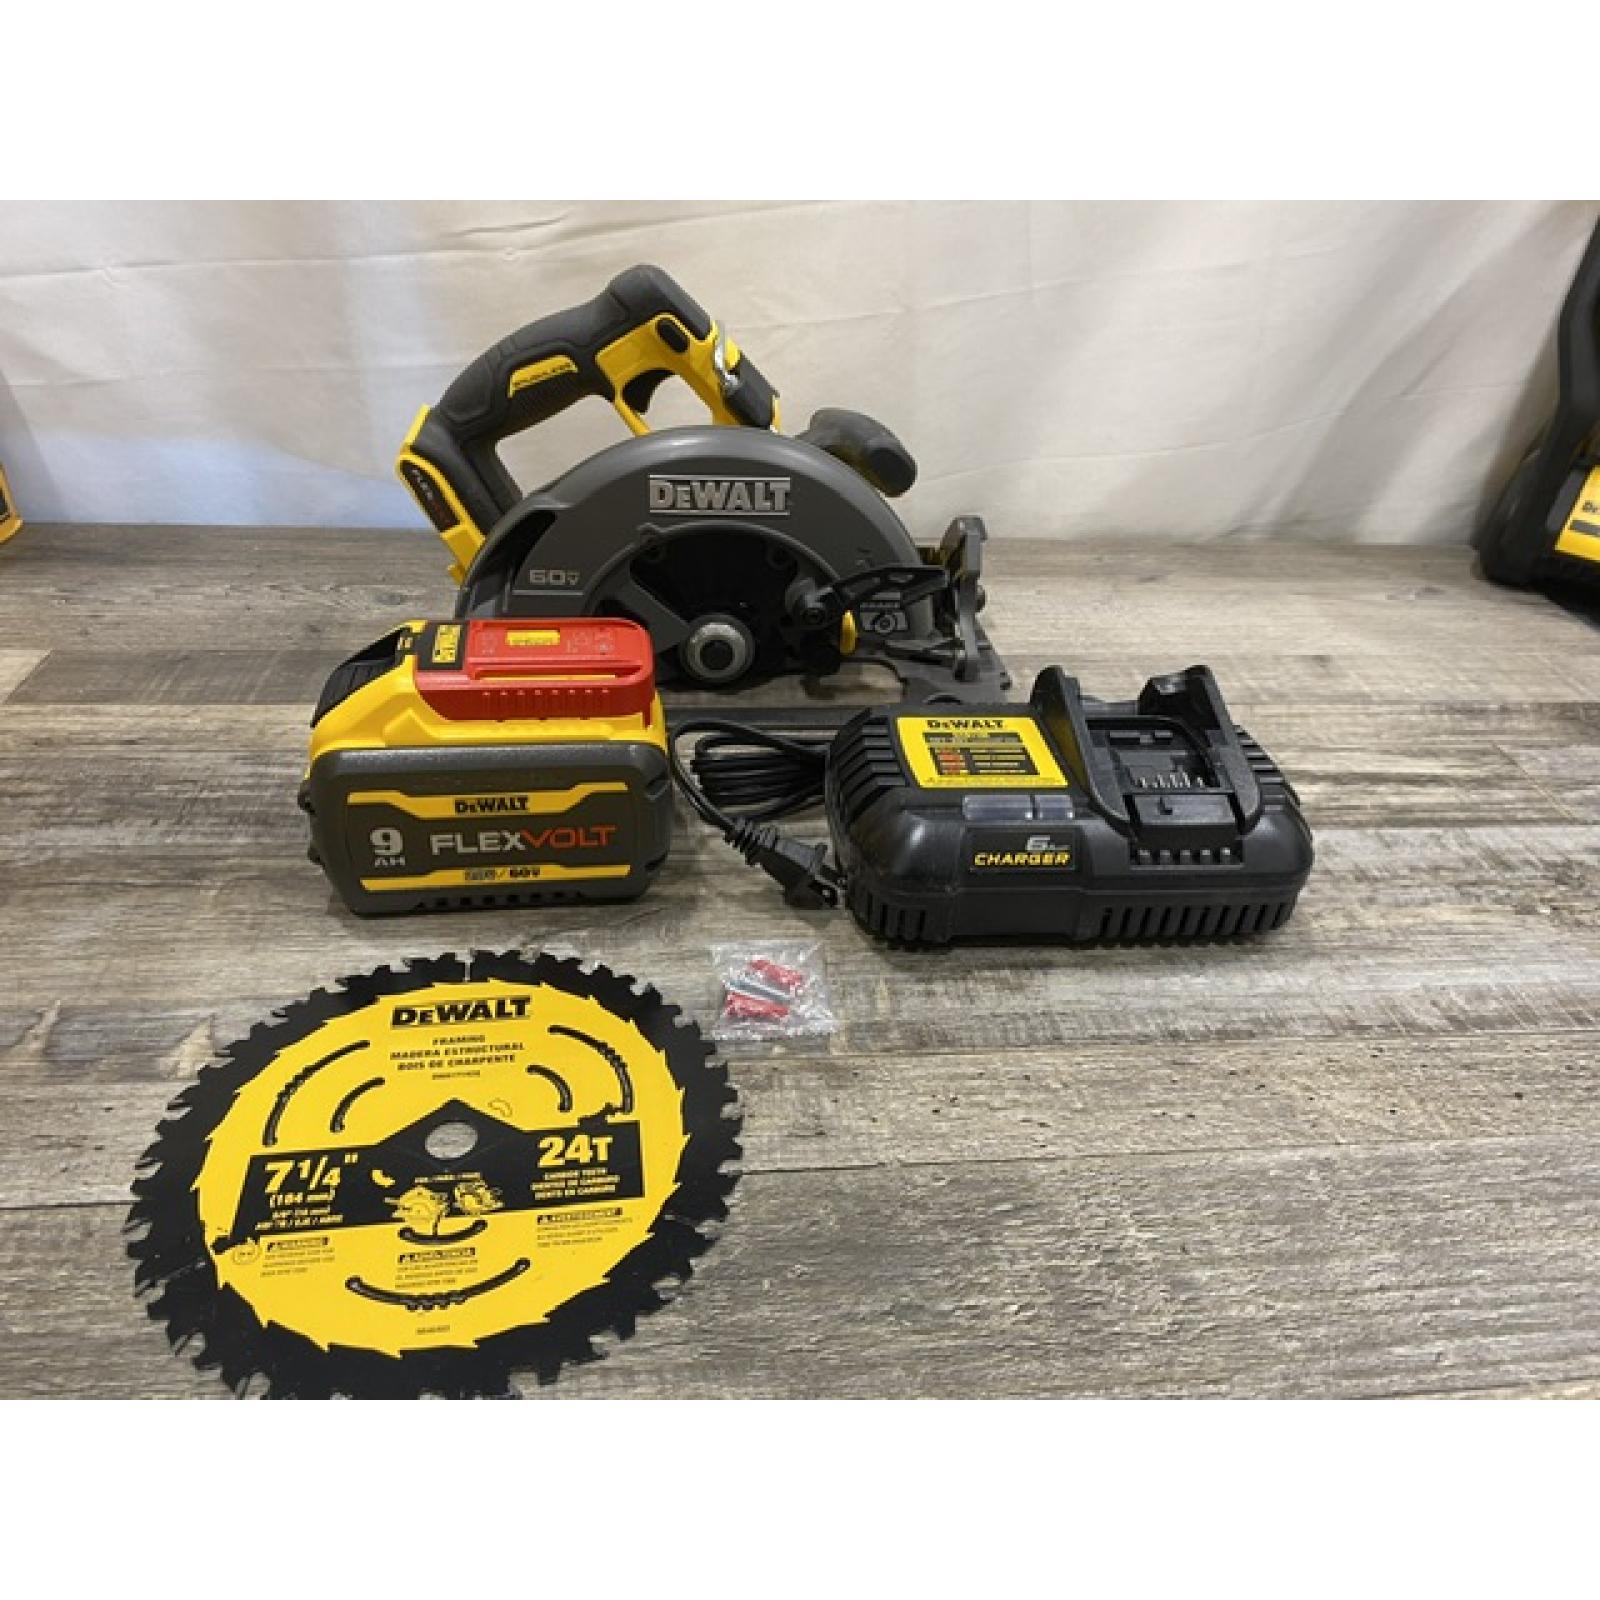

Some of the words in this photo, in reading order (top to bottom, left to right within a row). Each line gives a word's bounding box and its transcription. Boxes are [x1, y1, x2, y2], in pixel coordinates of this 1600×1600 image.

[649, 474, 791, 516] DEWALT
[454, 796, 529, 815] DEWALT
[369, 827, 403, 856] 9
[429, 825, 616, 856] FLEXVOLT
[974, 851, 1071, 866] CHARGER
[391, 995, 531, 1028] DEWALT
[390, 1049, 441, 1060] MADERA
[444, 1042, 525, 1056] ESTRUCTURAL
[537, 1134, 614, 1167] 24T
